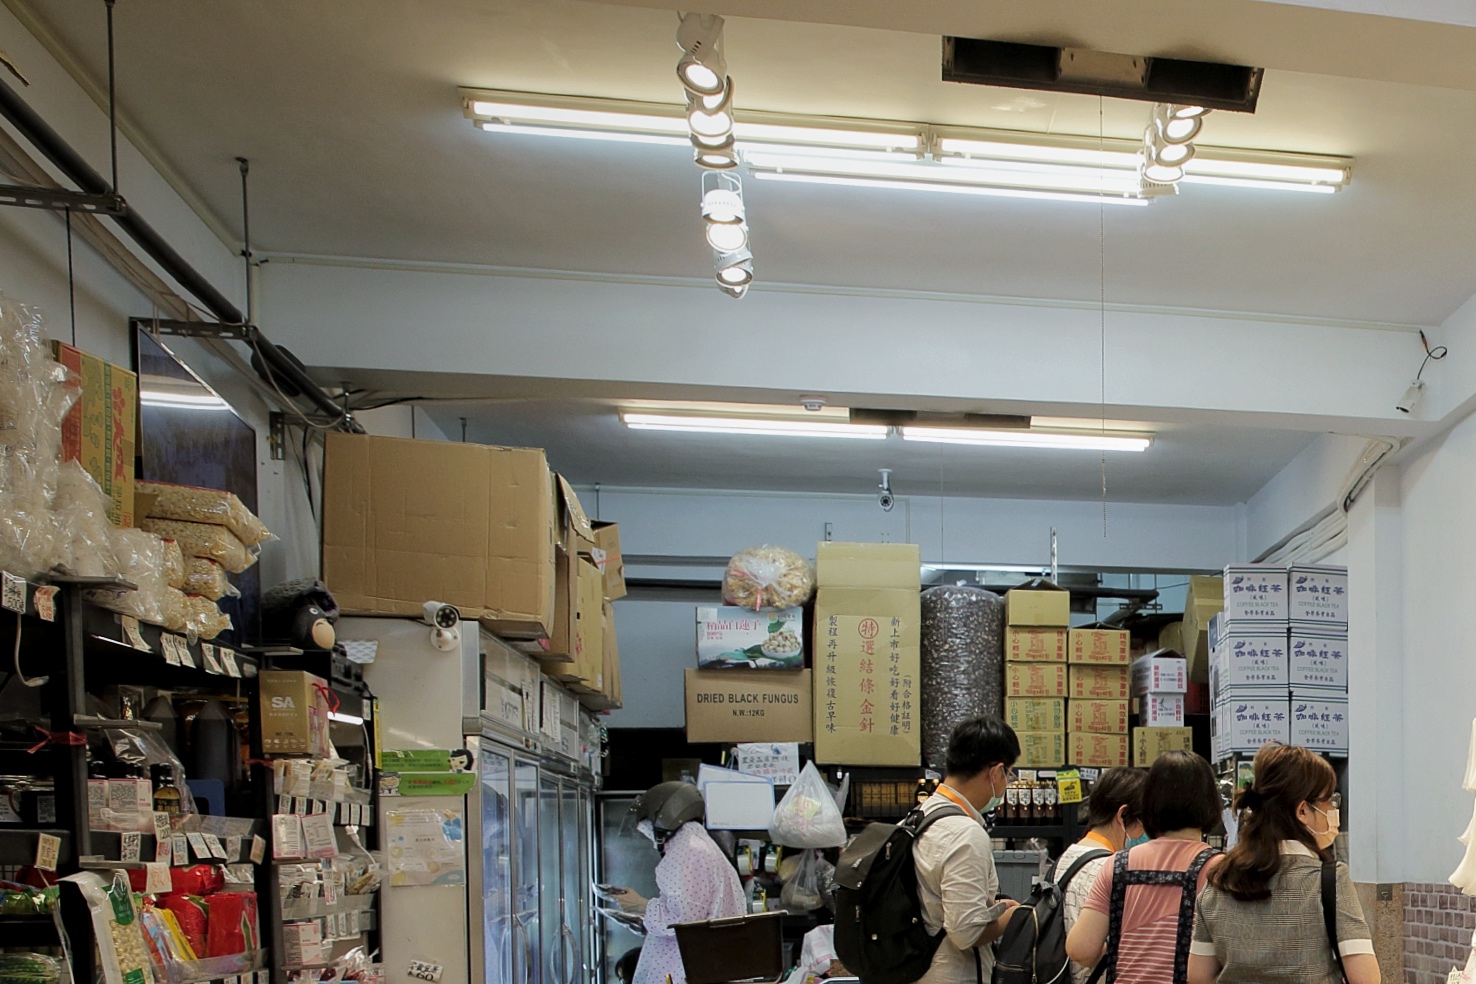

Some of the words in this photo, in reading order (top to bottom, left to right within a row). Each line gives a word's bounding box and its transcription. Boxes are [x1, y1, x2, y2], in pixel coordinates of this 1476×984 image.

[271, 696, 295, 708] SA
[697, 693, 725, 704] DRIED
[728, 693, 759, 704] BLACK
[762, 693, 799, 704] FUNGUS
[825, 615, 838, 734] 製程再升級恢復古早味
[858, 618, 879, 734] 特選結條金針
[889, 616, 901, 736] 新上市好吃好看好健康
